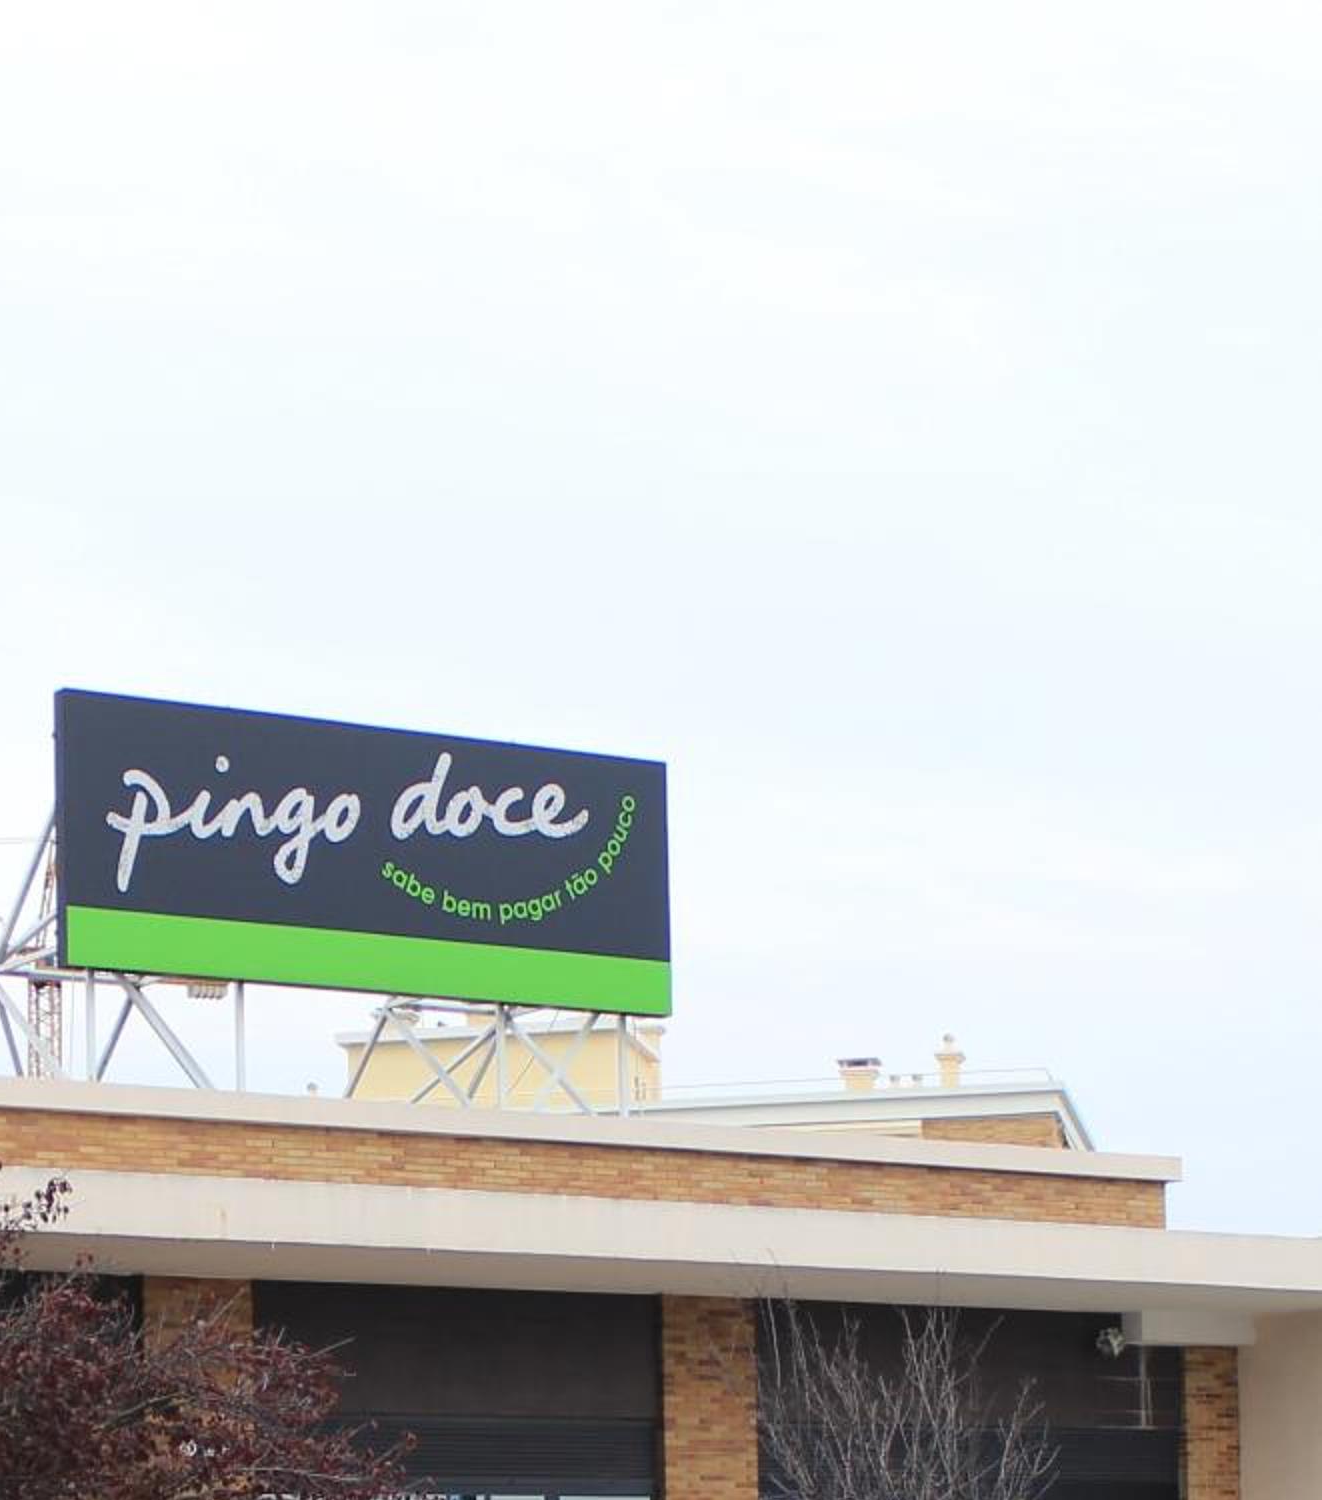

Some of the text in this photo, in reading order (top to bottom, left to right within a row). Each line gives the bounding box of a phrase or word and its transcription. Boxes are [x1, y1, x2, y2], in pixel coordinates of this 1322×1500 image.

[106, 751, 589, 893] pingo doce
[381, 795, 637, 925] sabe bem pagar tão pouco
